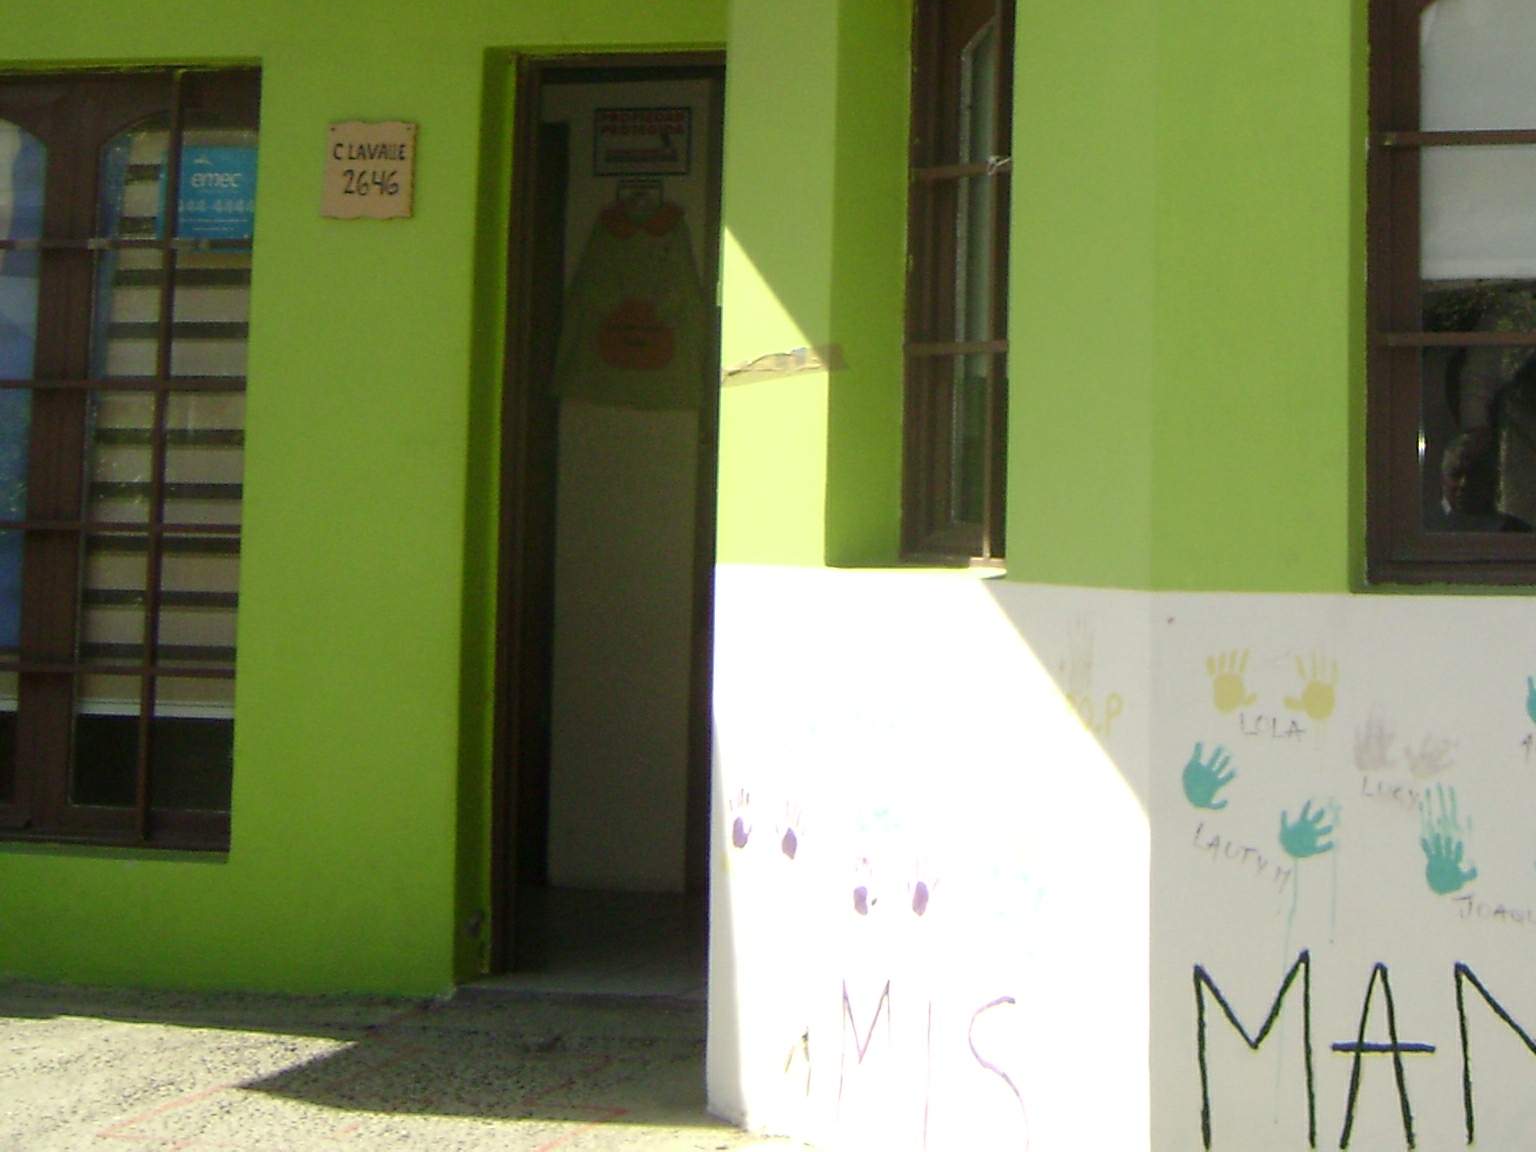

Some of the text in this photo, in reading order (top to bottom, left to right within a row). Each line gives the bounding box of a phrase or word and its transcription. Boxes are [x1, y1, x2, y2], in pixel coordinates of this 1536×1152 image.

[191, 171, 242, 189] emec
[343, 169, 399, 196] 2646
[1239, 711, 1306, 739] LOLA
